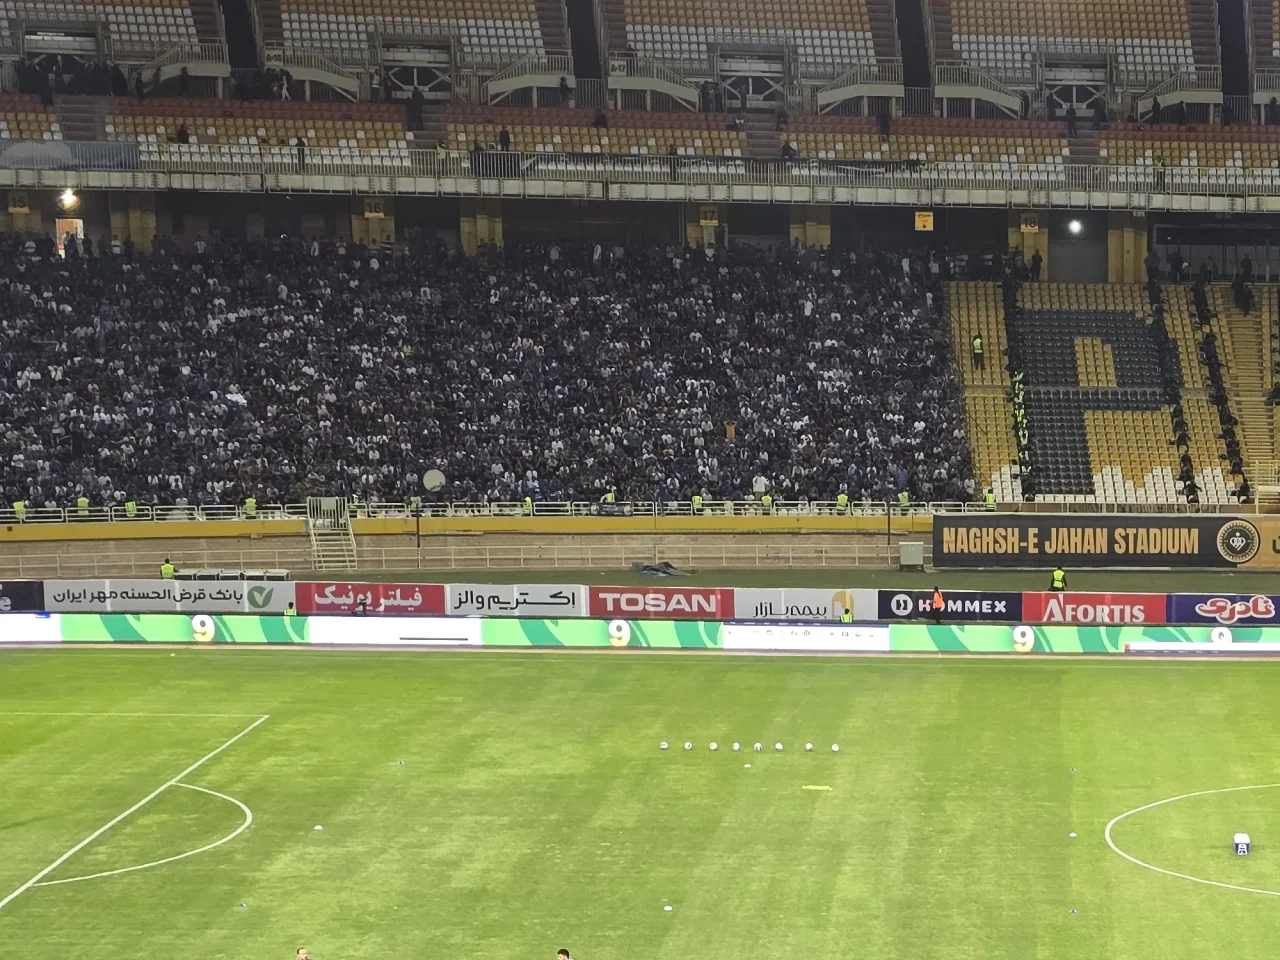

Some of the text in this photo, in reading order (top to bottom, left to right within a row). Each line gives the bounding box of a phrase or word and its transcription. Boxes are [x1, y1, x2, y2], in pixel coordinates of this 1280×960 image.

[10, 196, 26, 208] 15
[367, 201, 381, 213] 16
[702, 210, 716, 221] 17
[1022, 216, 1036, 228] 18
[942, 526, 1199, 554] NAGHSH-E JAHAN STADIUM
[53, 588, 244, 604] بانک قرض الحسنه مهر ایران
[375, 586, 423, 612] فیلتر
[599, 592, 717, 613] TOSAN
[918, 599, 1007, 614] HMMEX
[1042, 594, 1146, 623] AFORTIS
[1195, 595, 1276, 624] نادری
[191, 614, 216, 642] 9
[608, 619, 631, 647] 9
[1012, 625, 1035, 652] 9
